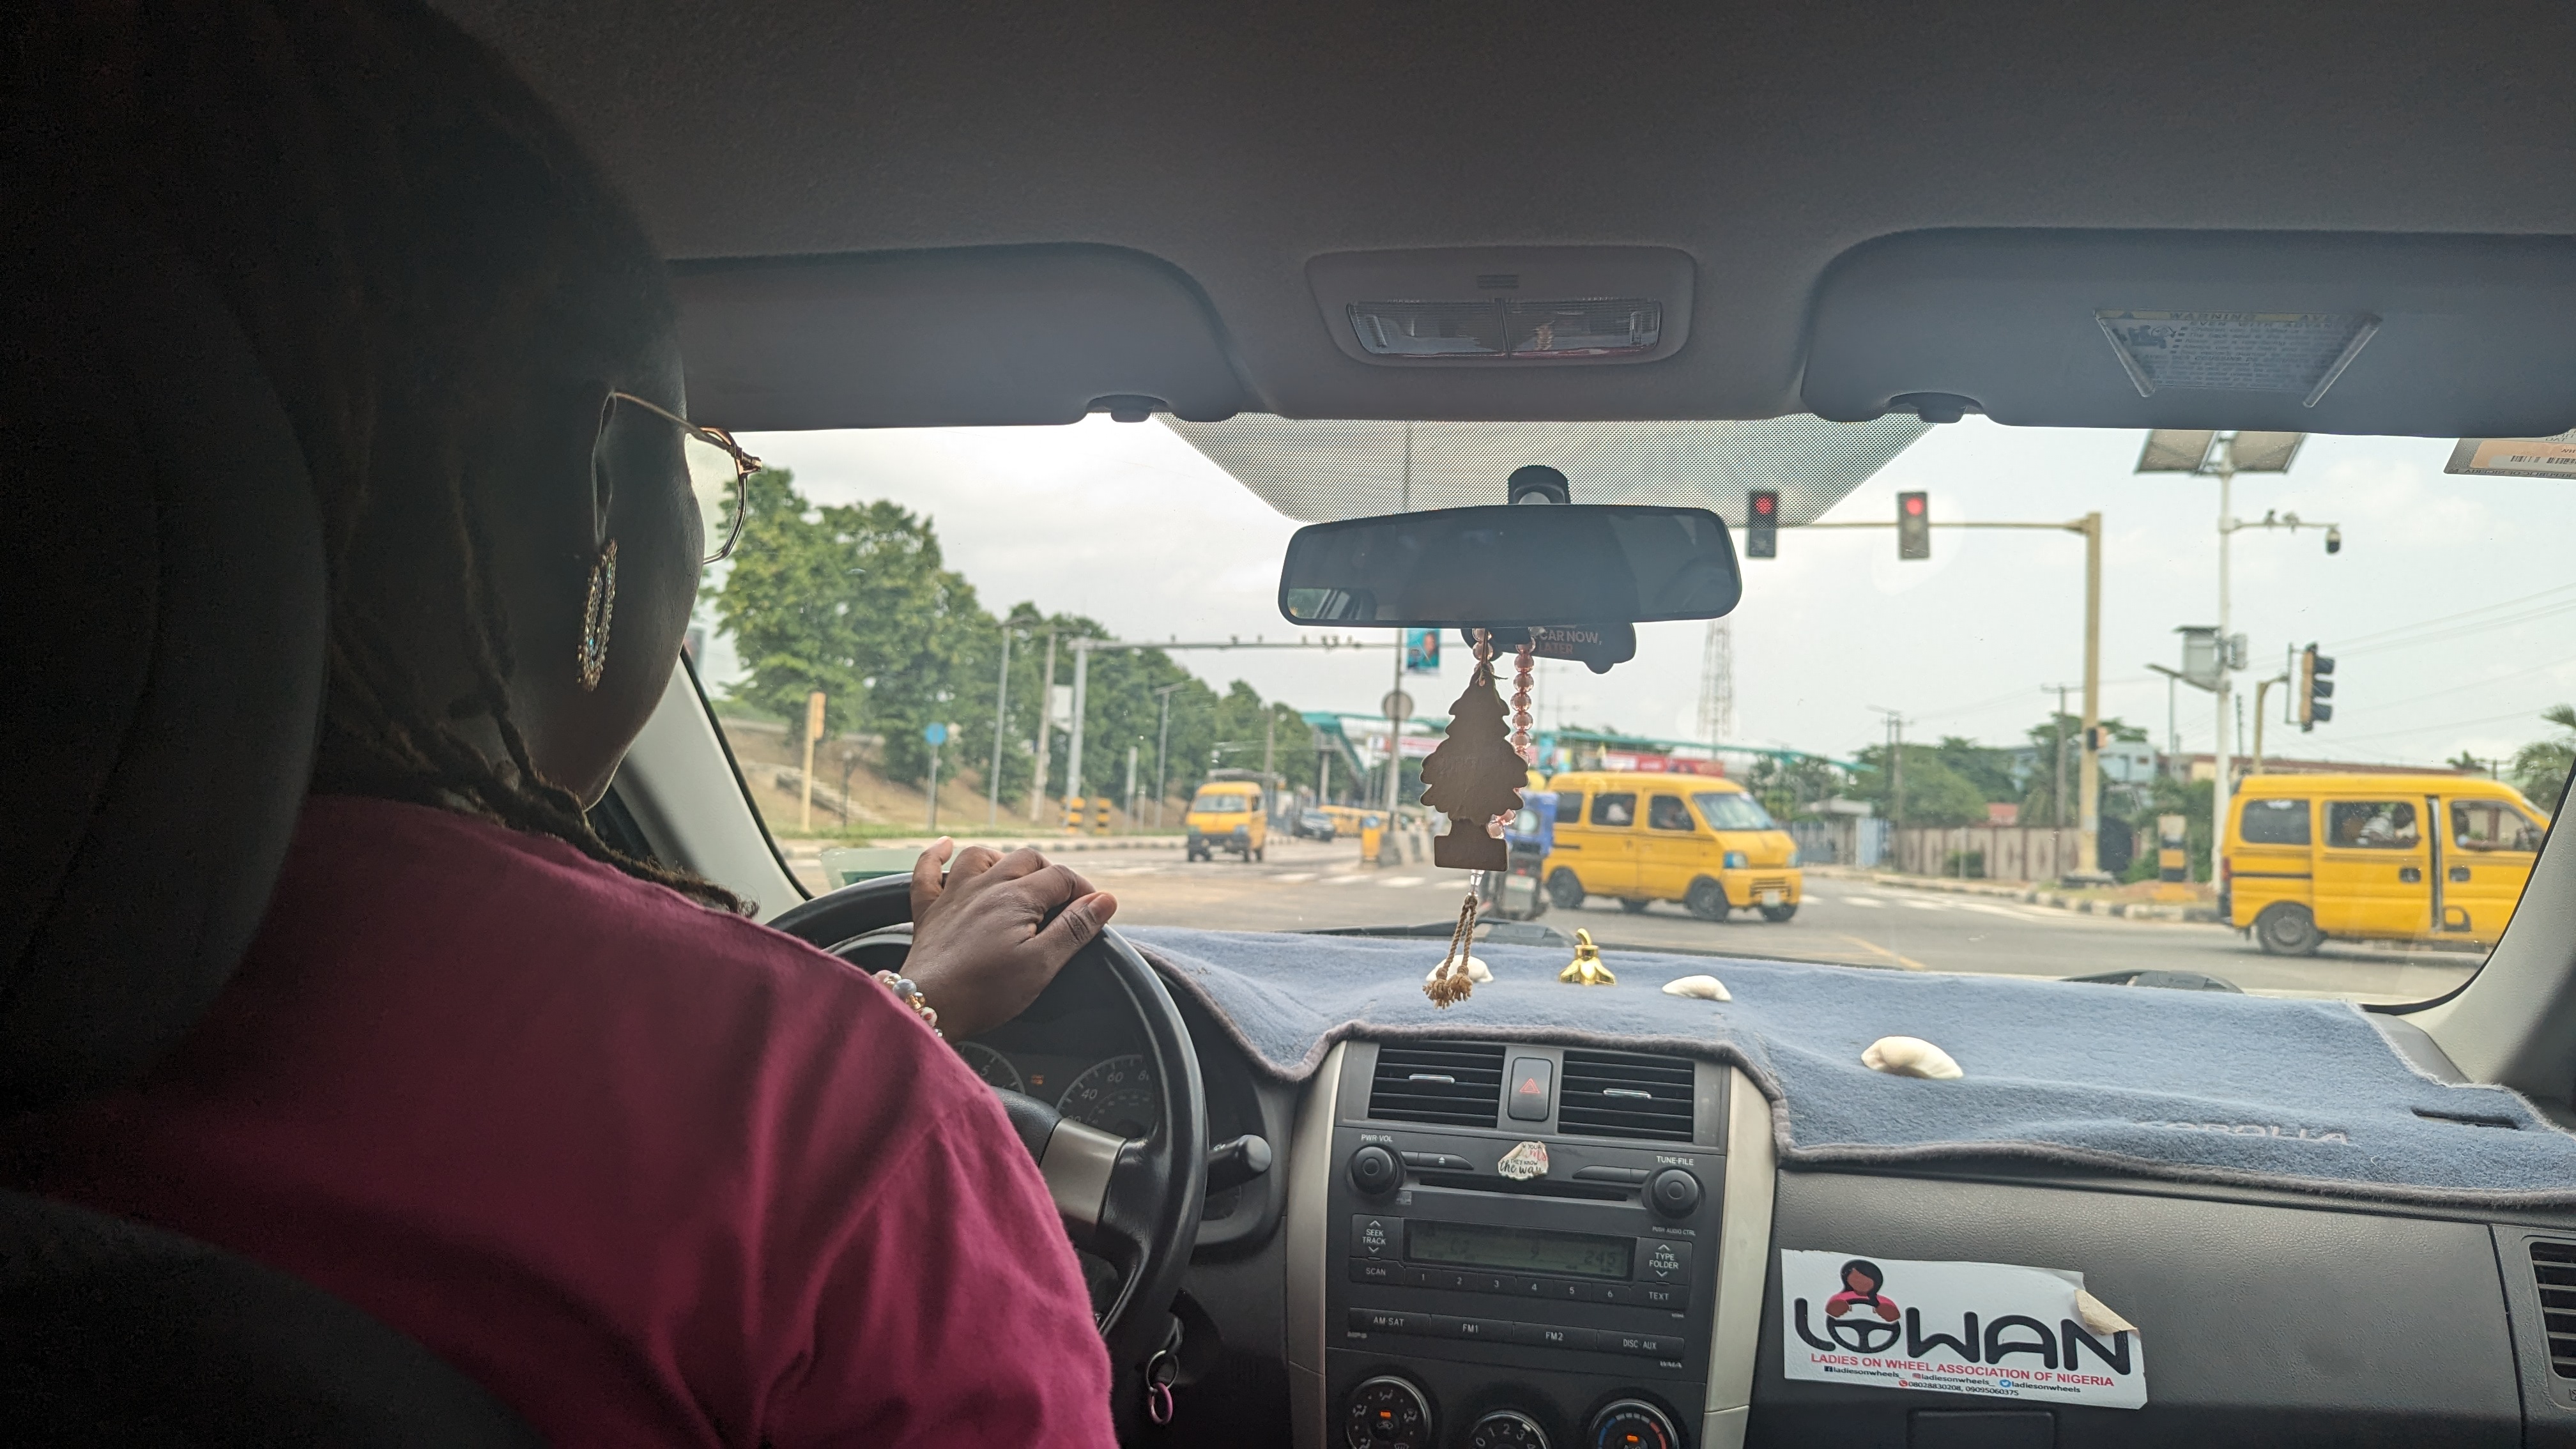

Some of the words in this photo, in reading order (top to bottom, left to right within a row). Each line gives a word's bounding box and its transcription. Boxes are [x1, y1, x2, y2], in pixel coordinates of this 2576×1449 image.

[1539, 629, 1565, 642] CAR
[1081, 1087, 1098, 1100] 40
[1366, 1228, 1384, 1237] SEEK
[1362, 1236, 1386, 1245] TRACK
[1655, 1252, 1675, 1261] TYPE
[1649, 1260, 1679, 1269] FOLDER
[1366, 1267, 1386, 1276] SCAN
[1457, 1276, 1462, 1285] 2
[1494, 1280, 1499, 1288] 3
[1531, 1283, 1537, 1291] 4
[1569, 1286, 1575, 1294] 5
[1607, 1290, 1614, 1298] 6
[1648, 1291, 1669, 1300] TEXT
[1462, 1323, 1479, 1333] FM1
[1545, 1331, 1563, 1341] FM2
[1623, 1338, 1638, 1348] DISC
[1643, 1340, 1657, 1350] AUX
[1811, 1353, 1858, 1366] LADIES
[1862, 1357, 1882, 1368] ON
[1885, 1358, 1934, 1372] WHEEL
[1936, 1363, 2030, 1380] ASSOCIATION
[2034, 1370, 2053, 1381] OF
[2057, 1372, 2115, 1386] NIGERIA
[2011, 1381, 2081, 1393] ladiesonwheels
[1503, 1423, 1510, 1435] 2
[1516, 1429, 1526, 1441] 3
